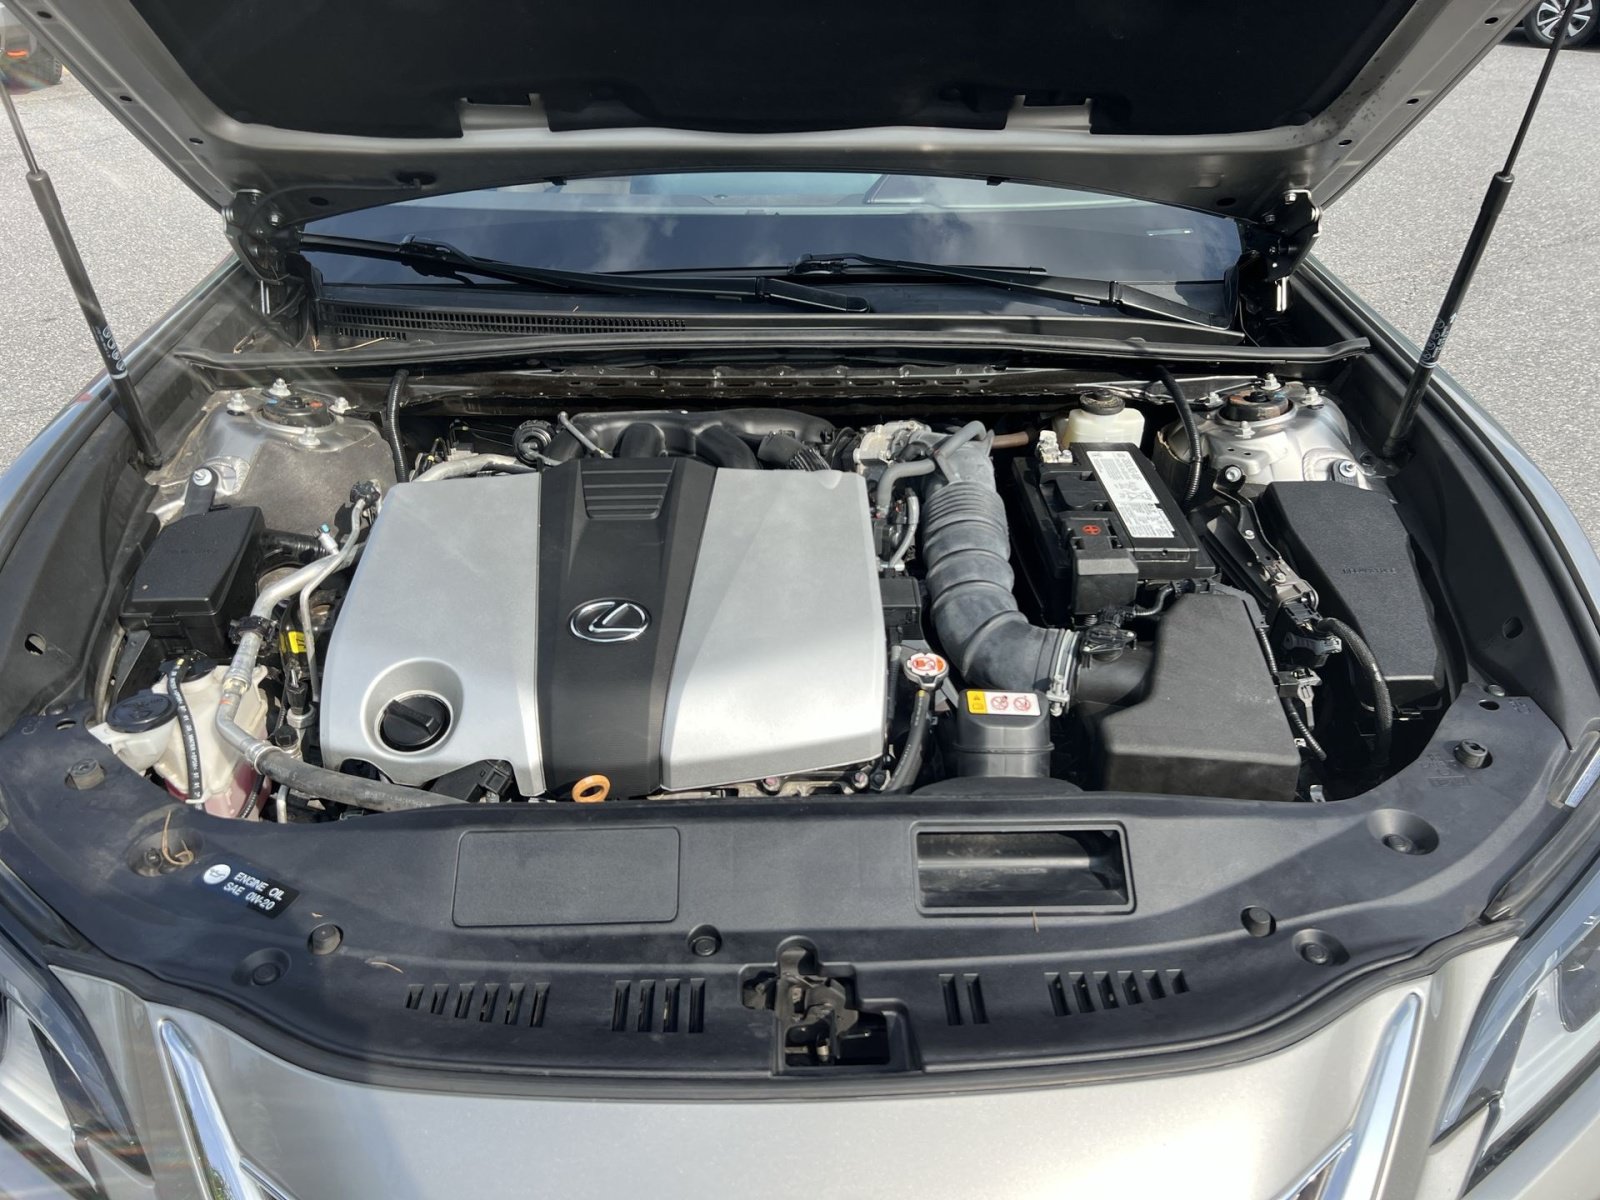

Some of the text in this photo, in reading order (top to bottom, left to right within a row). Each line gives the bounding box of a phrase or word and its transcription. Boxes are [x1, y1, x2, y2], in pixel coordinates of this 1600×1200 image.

[223, 881, 275, 910] SAE 0W-20
[234, 871, 285, 901] ENGINE OIL
